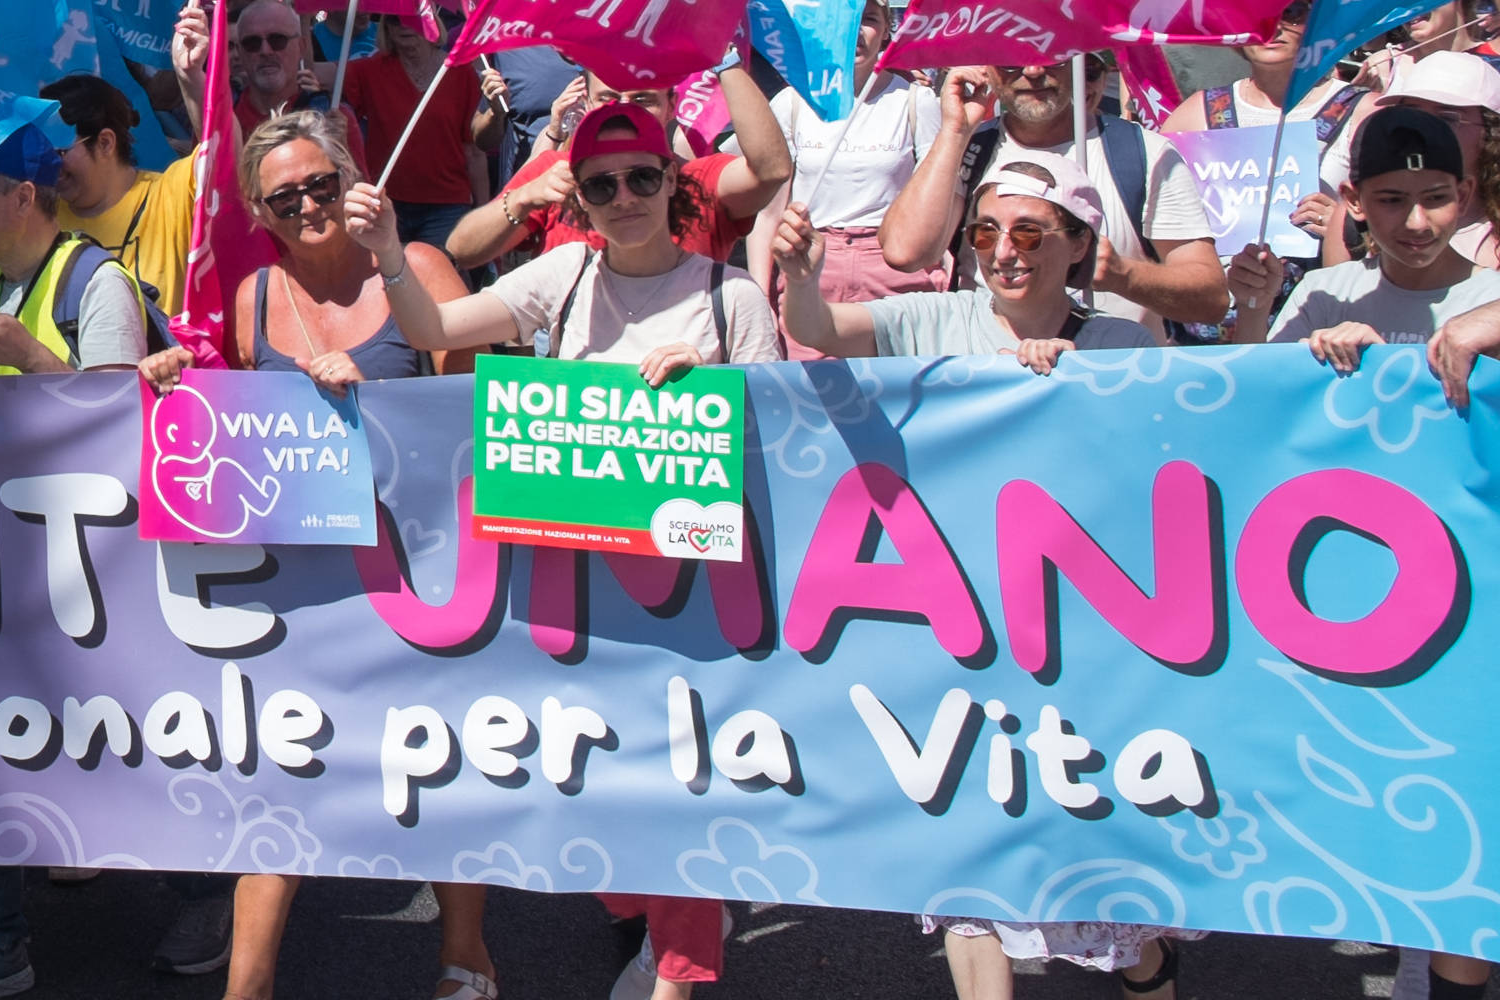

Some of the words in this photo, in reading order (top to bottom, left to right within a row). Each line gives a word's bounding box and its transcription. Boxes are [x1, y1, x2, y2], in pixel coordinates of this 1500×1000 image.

[891, 4, 1056, 52] PROVITA
[1193, 158, 1260, 181] VIVA
[487, 380, 568, 418] NOI
[579, 385, 732, 428] SIAMO
[220, 411, 299, 439] VIVA
[307, 411, 348, 440] LA
[485, 416, 522, 439] LA
[528, 420, 732, 454] GENERAZIONE
[263, 446, 350, 476] VITA!
[485, 441, 562, 475] PER
[572, 448, 625, 481] LA
[635, 452, 731, 488] VITA
[482, 524, 543, 537] MANIFESTAZIONE
[544, 530, 586, 541] NAZIONALE
[587, 533, 602, 542] PER
[603, 535, 613, 543] LA
[614, 536, 631, 544] VITA
[668, 520, 735, 534] SCEGLIAMO
[668, 532, 687, 544] LA
[352, 460, 1468, 684] UMANO
[380, 690, 612, 820] per
[667, 675, 800, 792] la
[848, 683, 1215, 815] Vita
